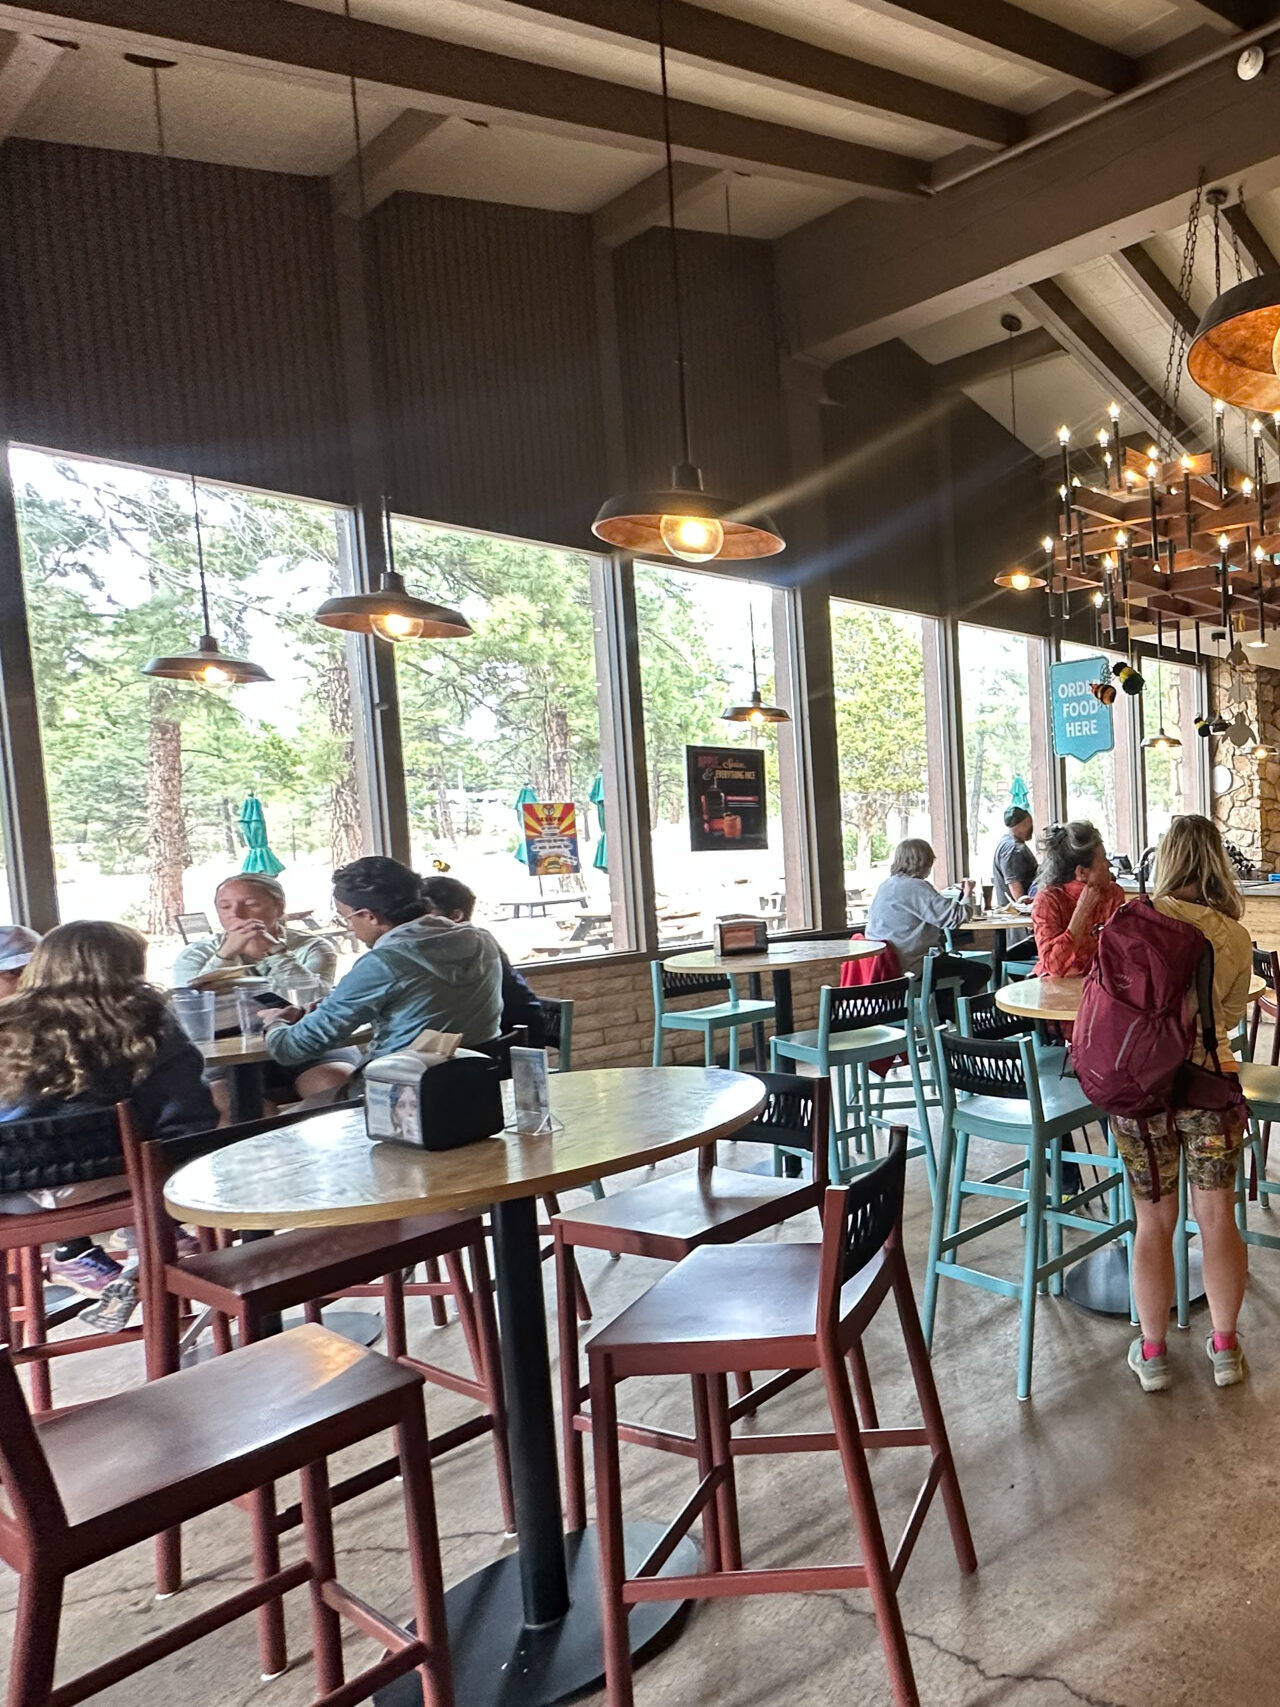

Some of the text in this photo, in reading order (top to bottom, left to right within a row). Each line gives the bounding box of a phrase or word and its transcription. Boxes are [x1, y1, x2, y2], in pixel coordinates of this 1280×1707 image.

[1058, 679, 1101, 698] ORDE
[1063, 701, 1098, 718] FOOD
[1066, 720, 1098, 737] HERE
